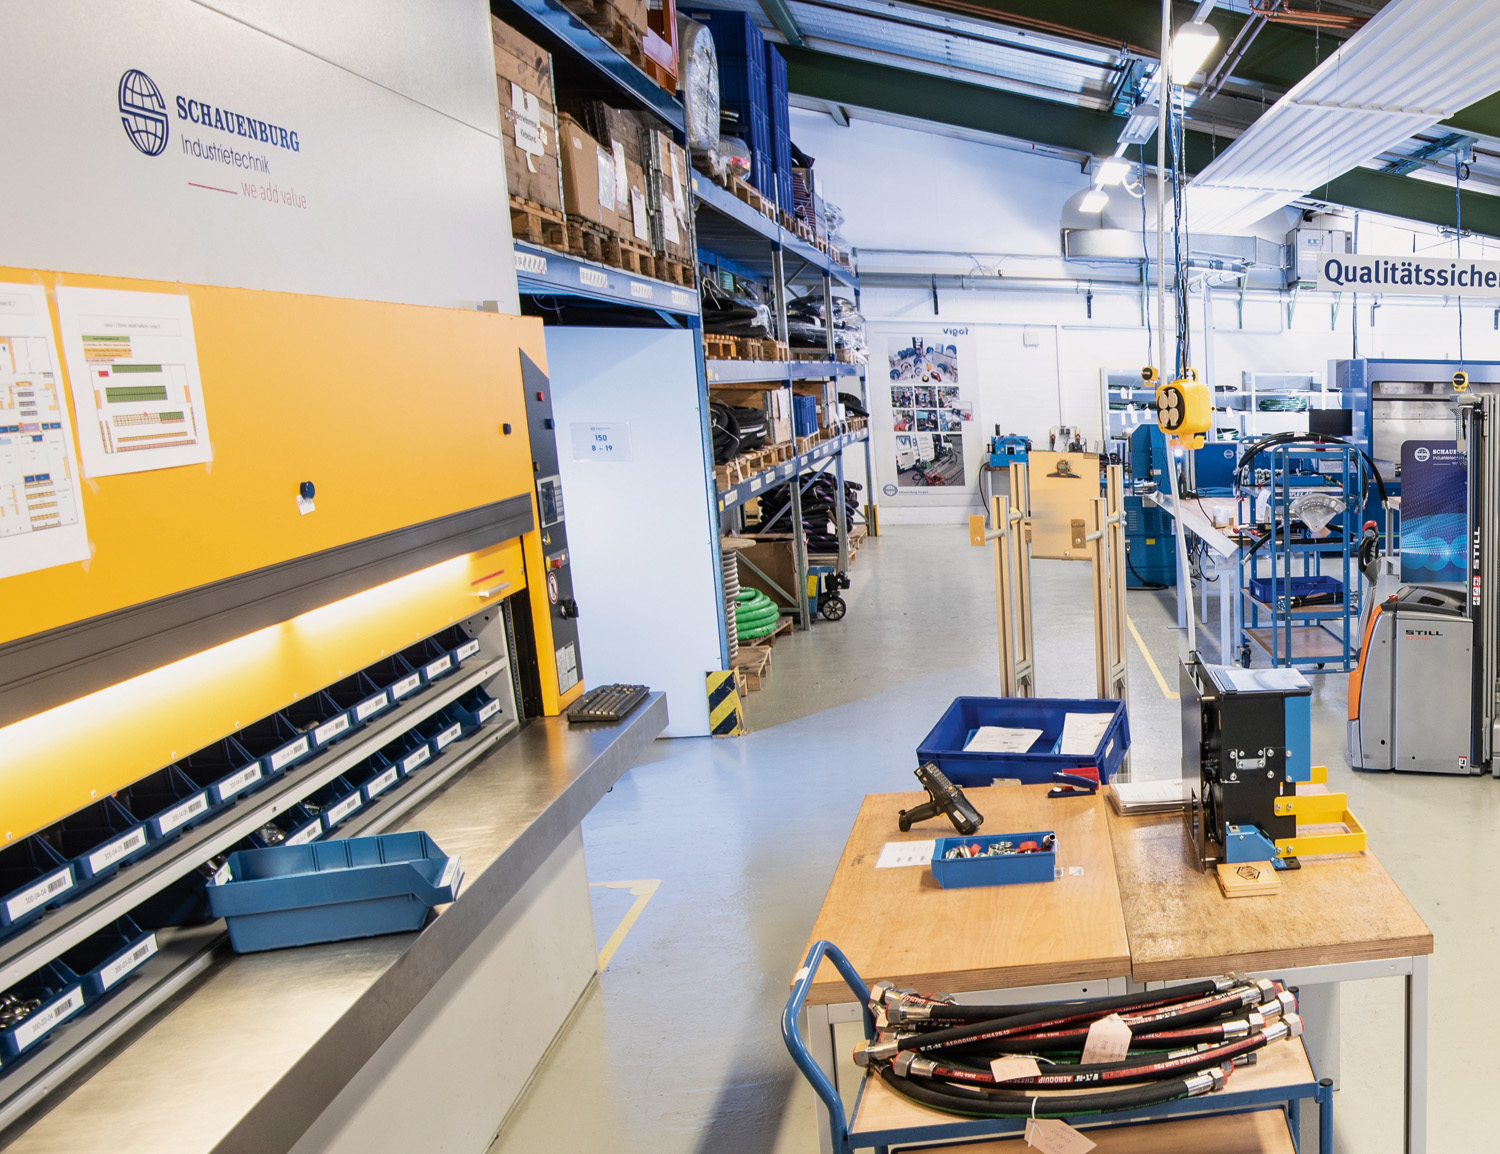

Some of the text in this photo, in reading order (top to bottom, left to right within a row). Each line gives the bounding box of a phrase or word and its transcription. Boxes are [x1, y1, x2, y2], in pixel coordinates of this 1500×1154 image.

[176, 96, 300, 152] SCHAUENBURG
[181, 134, 270, 174] Industrietechnik
[241, 182, 307, 209] we add value
[25, 888, 47, 905] 300-04-04
[32, 1013, 54, 1032] 300-03-04
[944, 1036, 978, 1047] AEROQUIP
[1038, 1075, 1072, 1084] AEROQUIP
